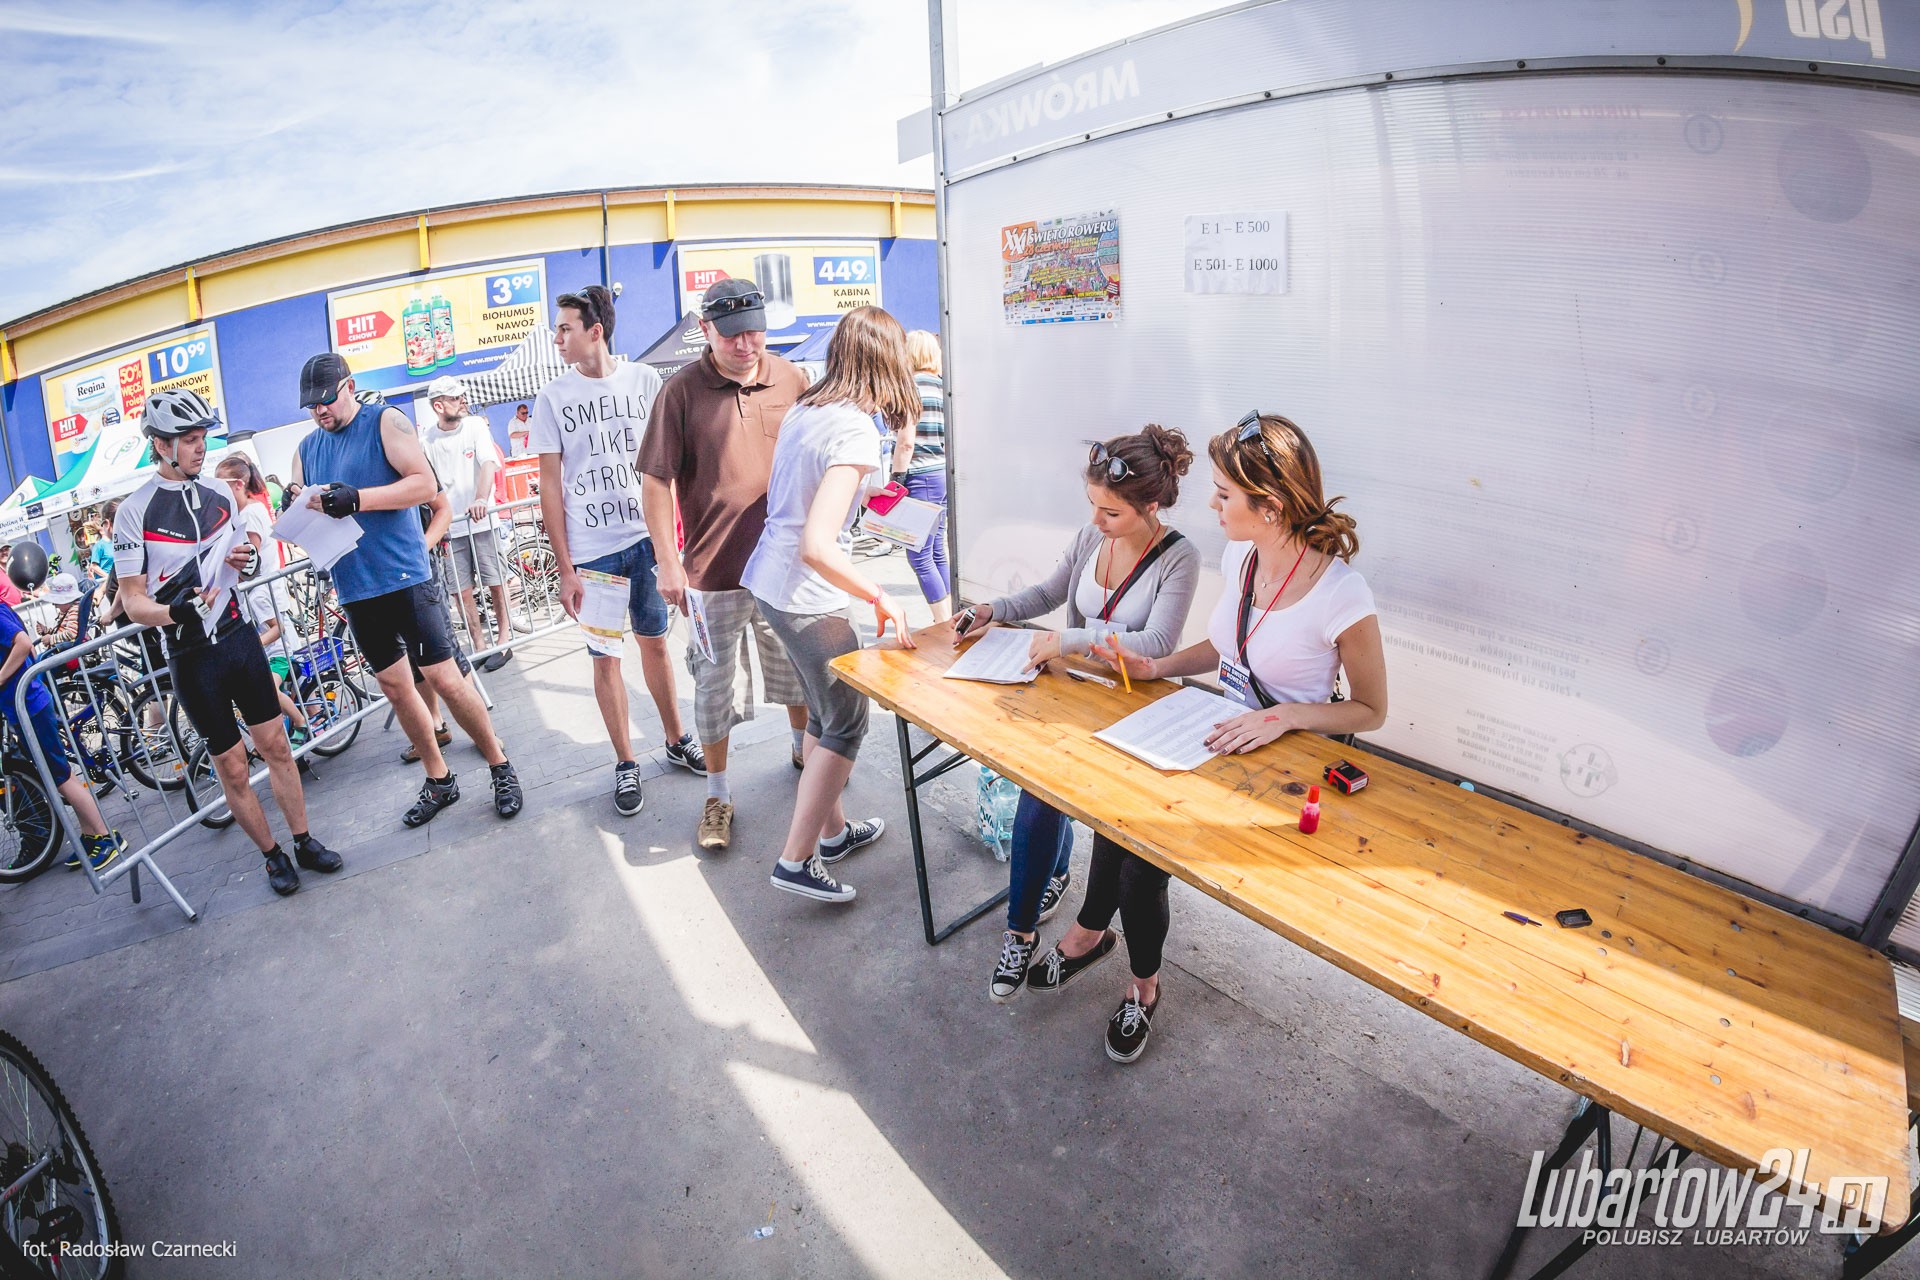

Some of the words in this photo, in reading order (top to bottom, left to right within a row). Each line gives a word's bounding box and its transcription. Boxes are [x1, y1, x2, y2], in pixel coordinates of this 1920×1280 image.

[1068, 220, 1117, 237] ROWERU
[1202, 222, 1210, 235] E
[1215, 222, 1221, 234] 1
[1235, 221, 1244, 233] E
[1247, 220, 1270, 233] 500
[1194, 258, 1202, 271] E
[1205, 258, 1232, 271] 501-
[1236, 258, 1245, 270] E
[1249, 258, 1278, 271] 1000
[694, 271, 718, 284] HIT
[492, 275, 533, 305] 399
[833, 288, 870, 297] KABINA
[482, 306, 535, 322] BIOHUMUS
[347, 315, 377, 335] HIT
[496, 317, 535, 331] NAWÓZ
[348, 330, 377, 342] CENOWY
[119, 364, 143, 385] 50%
[77, 380, 106, 397] Regina
[562, 395, 647, 433] SMELLS
[59, 417, 77, 434] HIT
[588, 427, 637, 457] LIKE
[574, 462, 642, 496] STRON
[585, 497, 641, 528] SPIR
